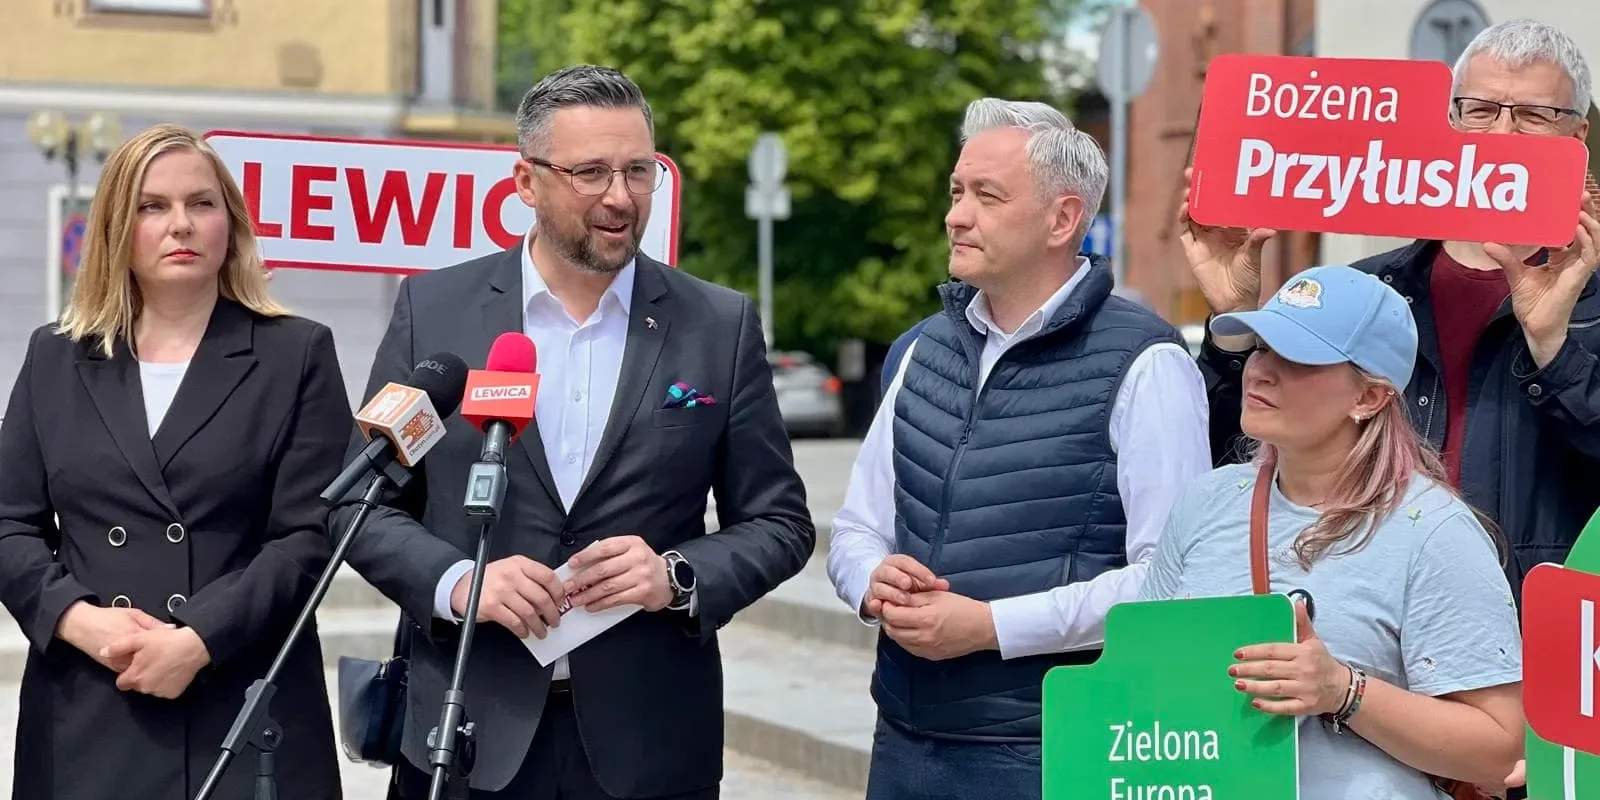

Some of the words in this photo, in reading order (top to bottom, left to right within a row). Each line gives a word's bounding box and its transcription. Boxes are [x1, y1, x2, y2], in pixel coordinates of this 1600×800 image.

[1246, 70, 1398, 122] Bożena
[1234, 139, 1528, 217] Przyłuska
[243, 162, 525, 250] LEWIC
[475, 387, 528, 398] LEWICA
[1108, 721, 1219, 761] Zielona
